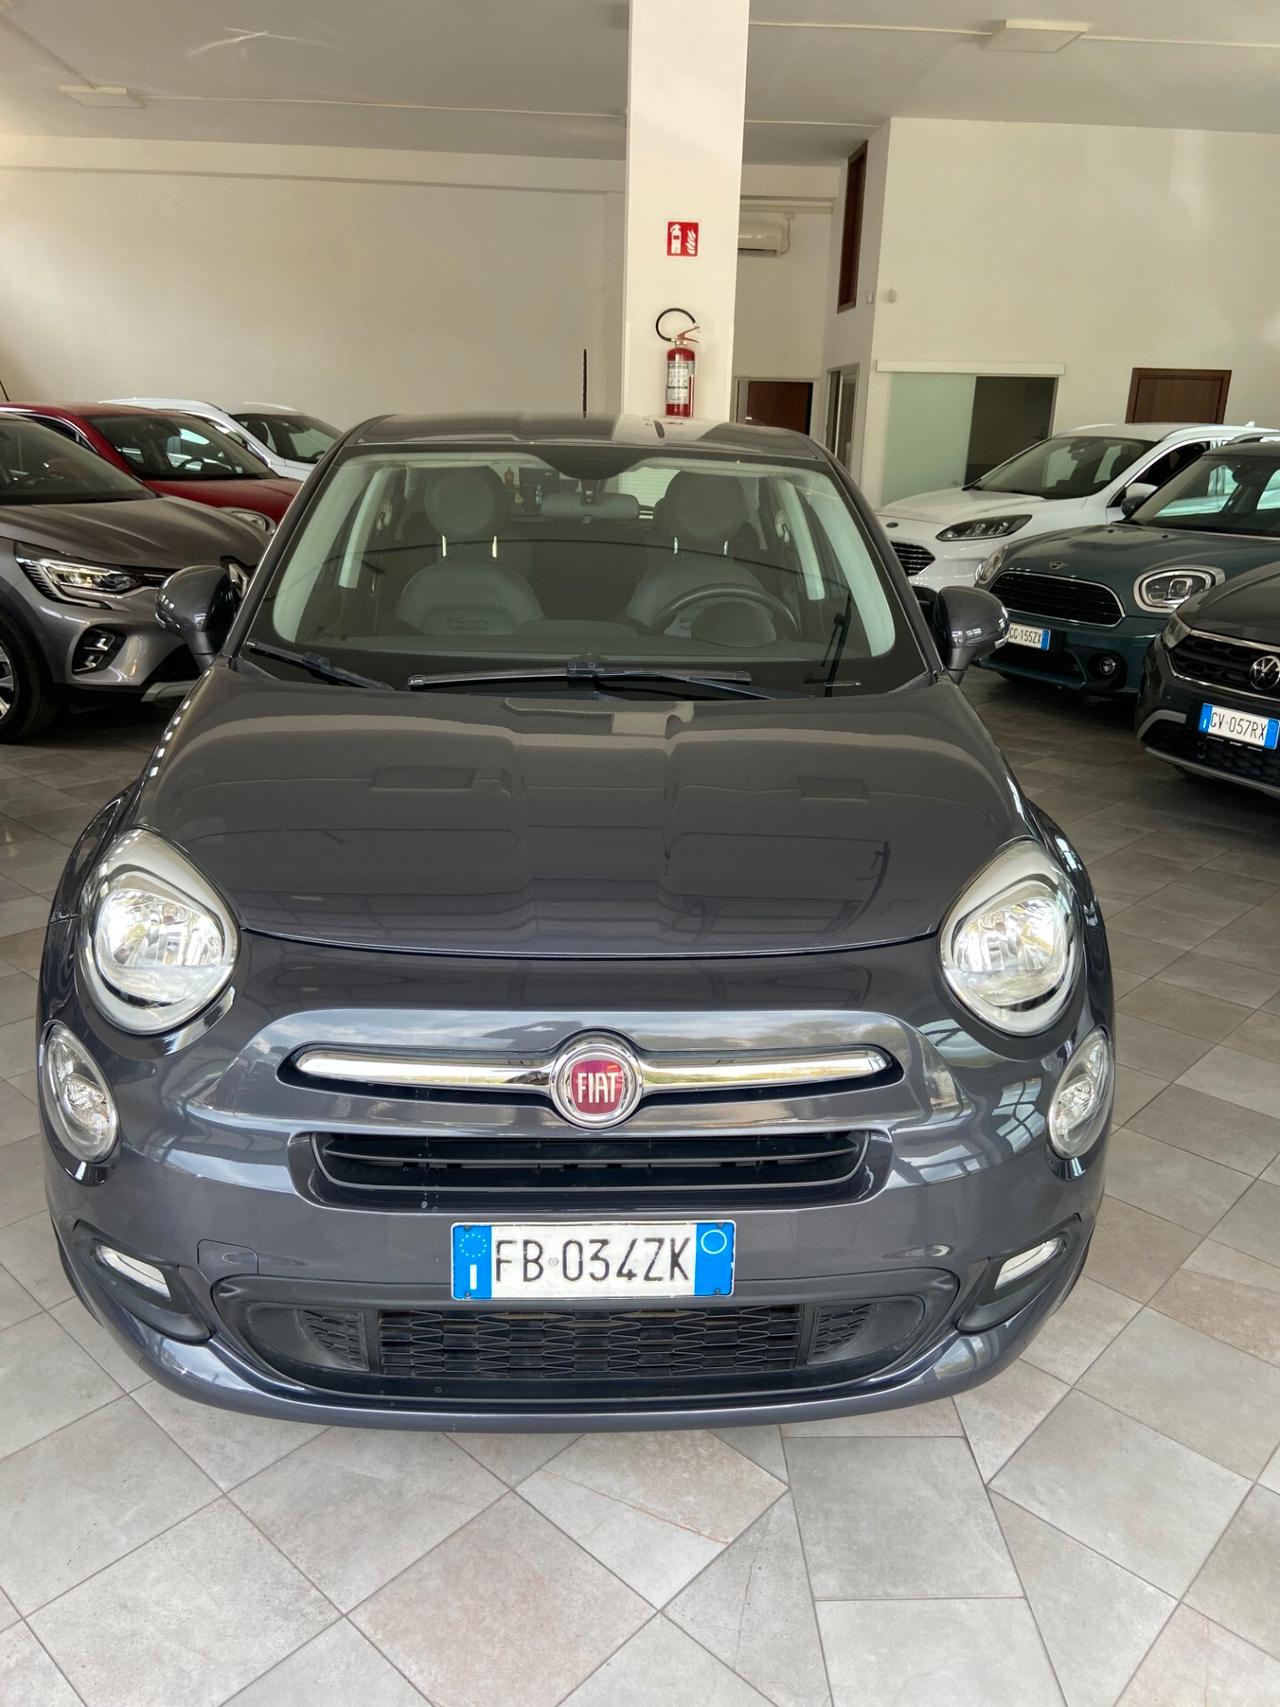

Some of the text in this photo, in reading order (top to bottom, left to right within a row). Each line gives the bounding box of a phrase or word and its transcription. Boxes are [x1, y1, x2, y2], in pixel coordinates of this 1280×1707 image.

[1211, 712, 1266, 740] GV 057RX
[577, 1071, 619, 1104] FIAT
[495, 1237, 691, 1283] FB 034ZK
